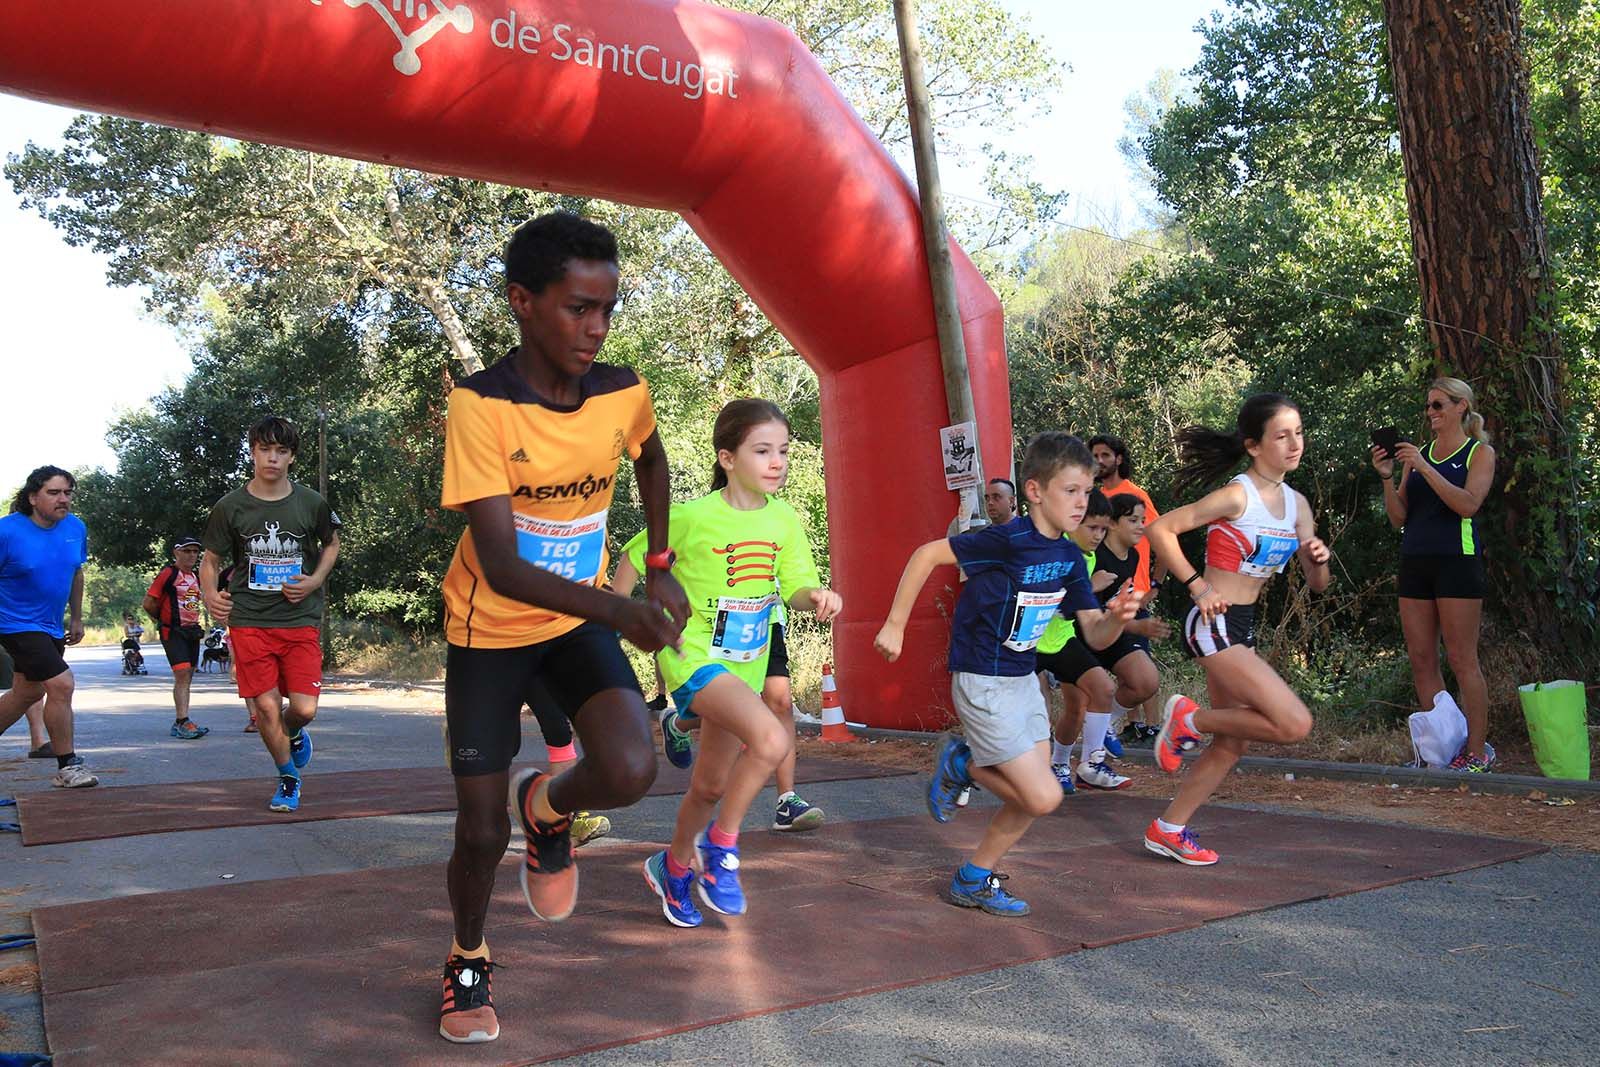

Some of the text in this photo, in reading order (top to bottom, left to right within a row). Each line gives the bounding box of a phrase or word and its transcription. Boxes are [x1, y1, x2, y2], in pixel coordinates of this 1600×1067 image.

[490, 10, 740, 100] de SantCugat
[541, 541, 581, 558] TEO
[262, 566, 292, 574] MARK
[267, 575, 288, 584] 504
